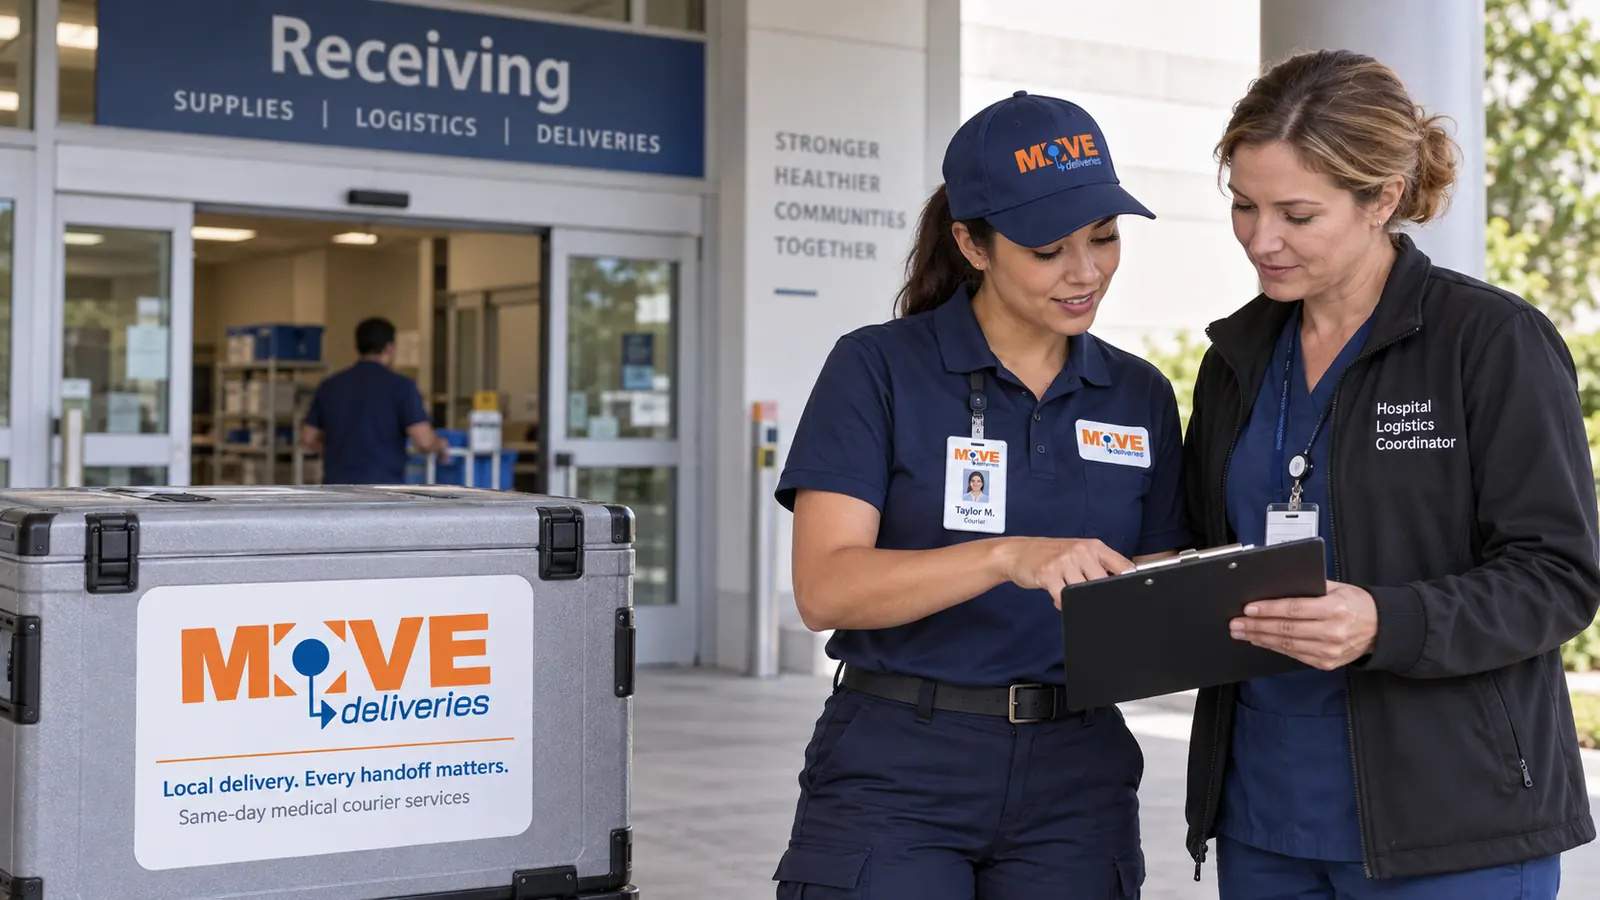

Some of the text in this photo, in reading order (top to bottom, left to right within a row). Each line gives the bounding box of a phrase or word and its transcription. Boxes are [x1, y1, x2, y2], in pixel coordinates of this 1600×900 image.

[271, 15, 570, 114] Receiving
[174, 90, 661, 154] SUPPLIES LOGISTICS DELIVERIES
[775, 131, 880, 159] STRONGER
[1014, 134, 1098, 174] MOVE
[1066, 157, 1102, 170] deliveries
[774, 167, 881, 193] HEALTHIER
[774, 201, 907, 229] COMMUNITIES
[774, 235, 878, 261] TOGETHER
[1377, 399, 1431, 416] Hospital
[1082, 429, 1144, 451] MOVE
[1376, 418, 1435, 435] Logistics
[954, 448, 1000, 463] MOVE
[1376, 436, 1456, 450] Coordinator
[955, 506, 995, 517] Taylor M.
[181, 613, 491, 704] MOVE
[341, 691, 490, 724] deliveries
[163, 759, 509, 797] Local delivery. Every handoff matters.
[178, 790, 470, 826] Same-day medical courier services
